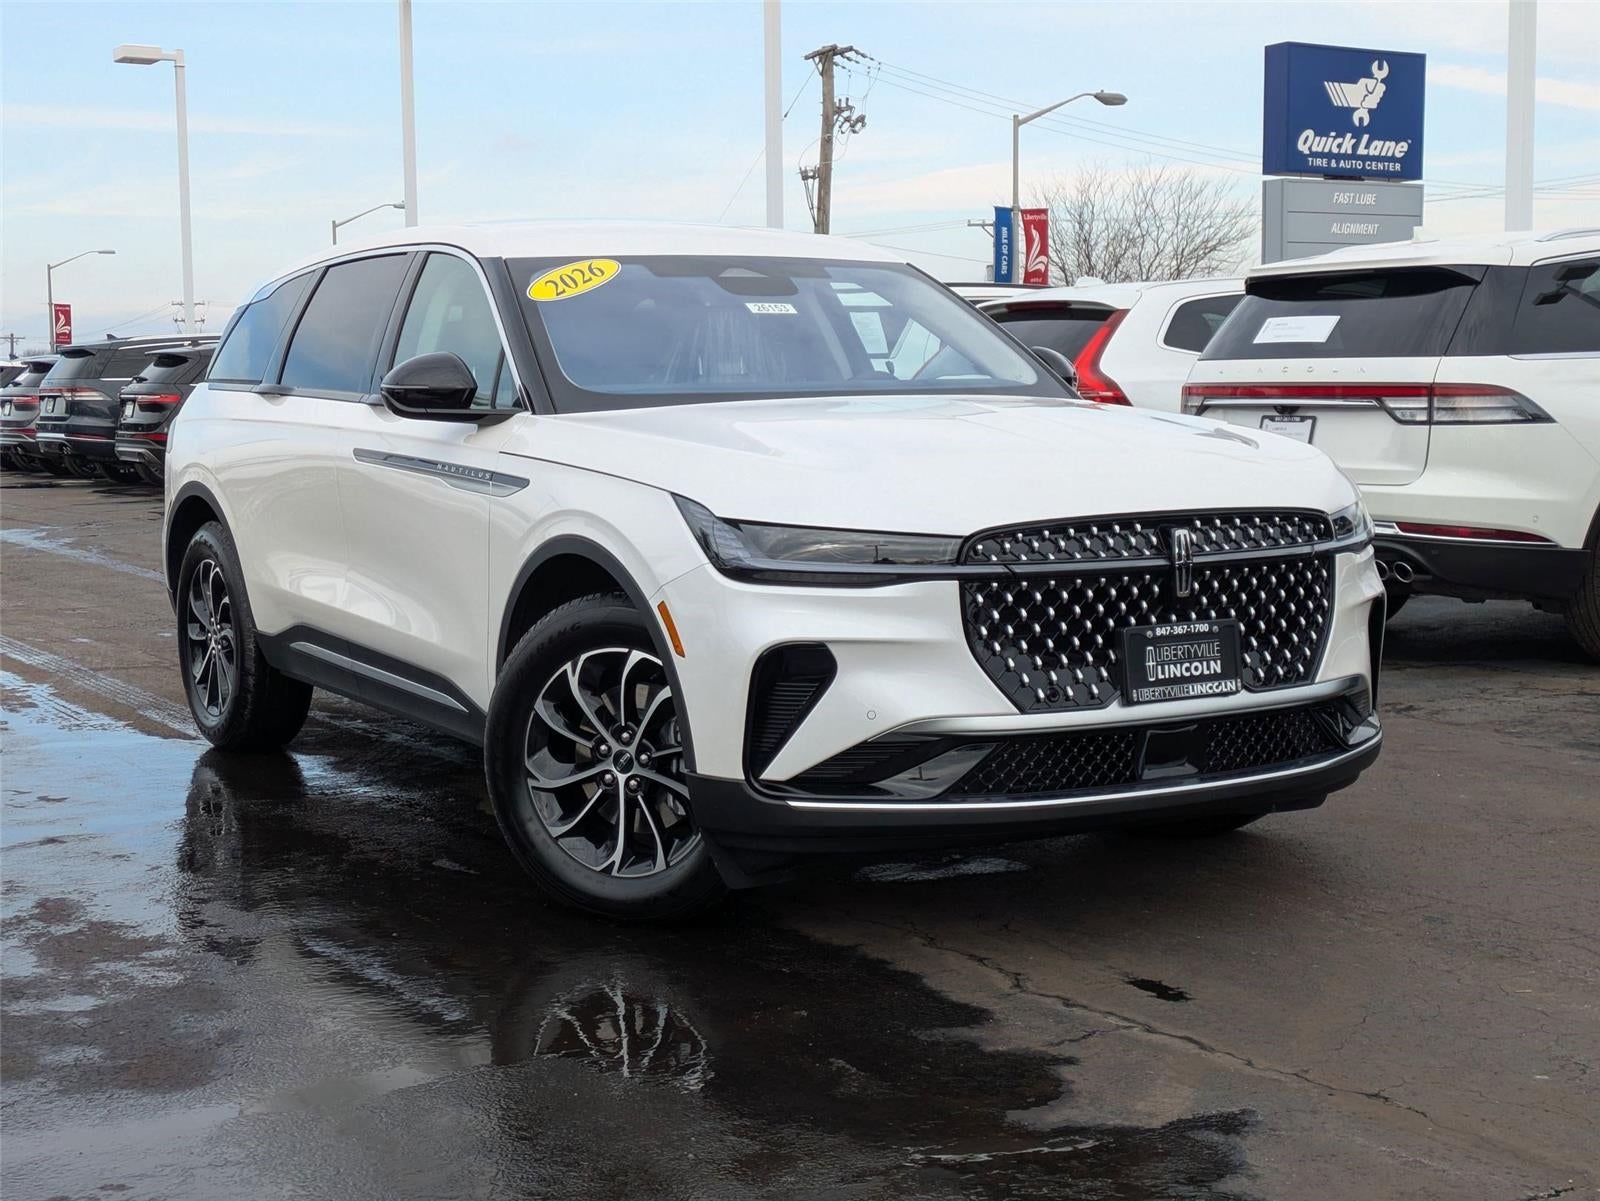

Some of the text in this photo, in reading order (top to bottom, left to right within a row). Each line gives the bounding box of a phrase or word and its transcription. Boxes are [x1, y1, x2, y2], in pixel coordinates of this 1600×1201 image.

[1297, 129, 1409, 158] Quick Lane
[1308, 157, 1401, 171] TIRE & AUTO CENTER
[1333, 192, 1376, 205] FAST LUBE
[1331, 223, 1379, 235] ALIGNMENT
[1001, 245, 1008, 254] OF
[544, 262, 606, 297] 2026
[753, 303, 790, 312] 26153
[436, 463, 491, 479] NAUTILUS
[1155, 624, 1209, 636] 847-367-1700
[1156, 642, 1221, 661] LIBERTYVILLE
[1157, 660, 1222, 680] LINCOLN
